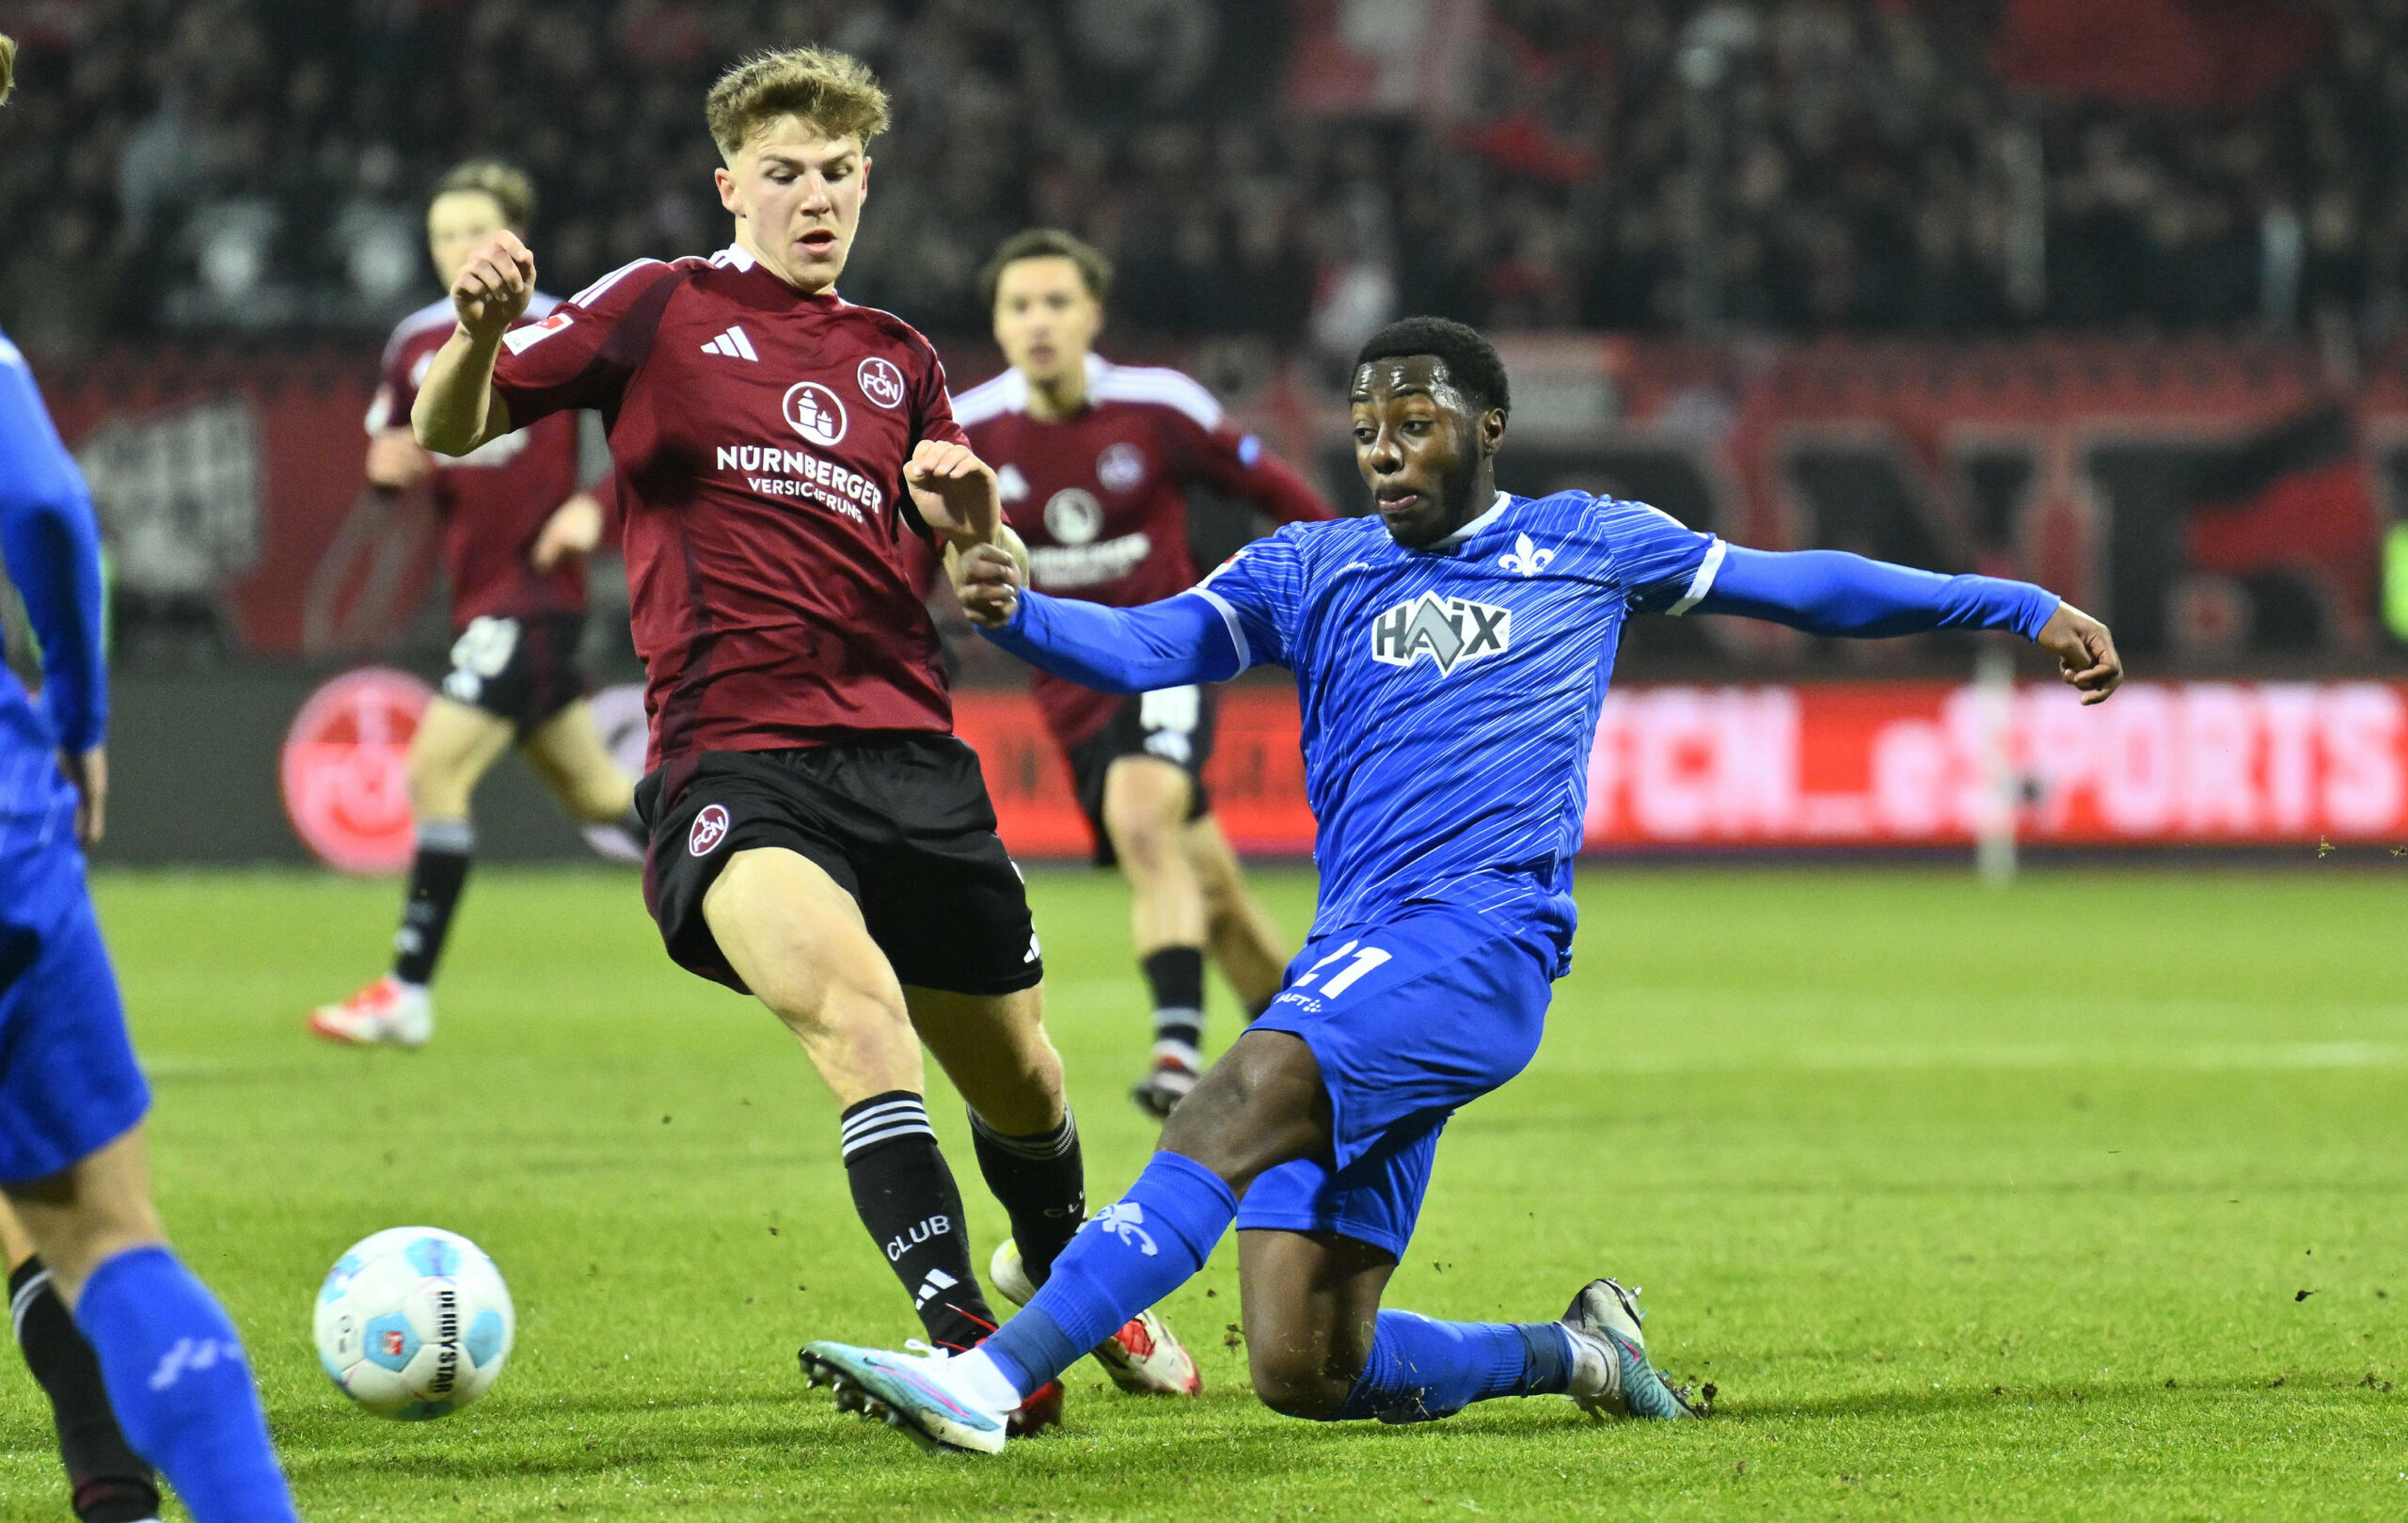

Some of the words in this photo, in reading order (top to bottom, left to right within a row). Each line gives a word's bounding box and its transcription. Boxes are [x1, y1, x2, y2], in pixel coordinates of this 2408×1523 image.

[862, 372, 899, 401] FCN
[717, 445, 882, 515] NÜRNBERGER
[693, 815, 725, 852] FCN
[886, 1214, 951, 1262] CLUB
